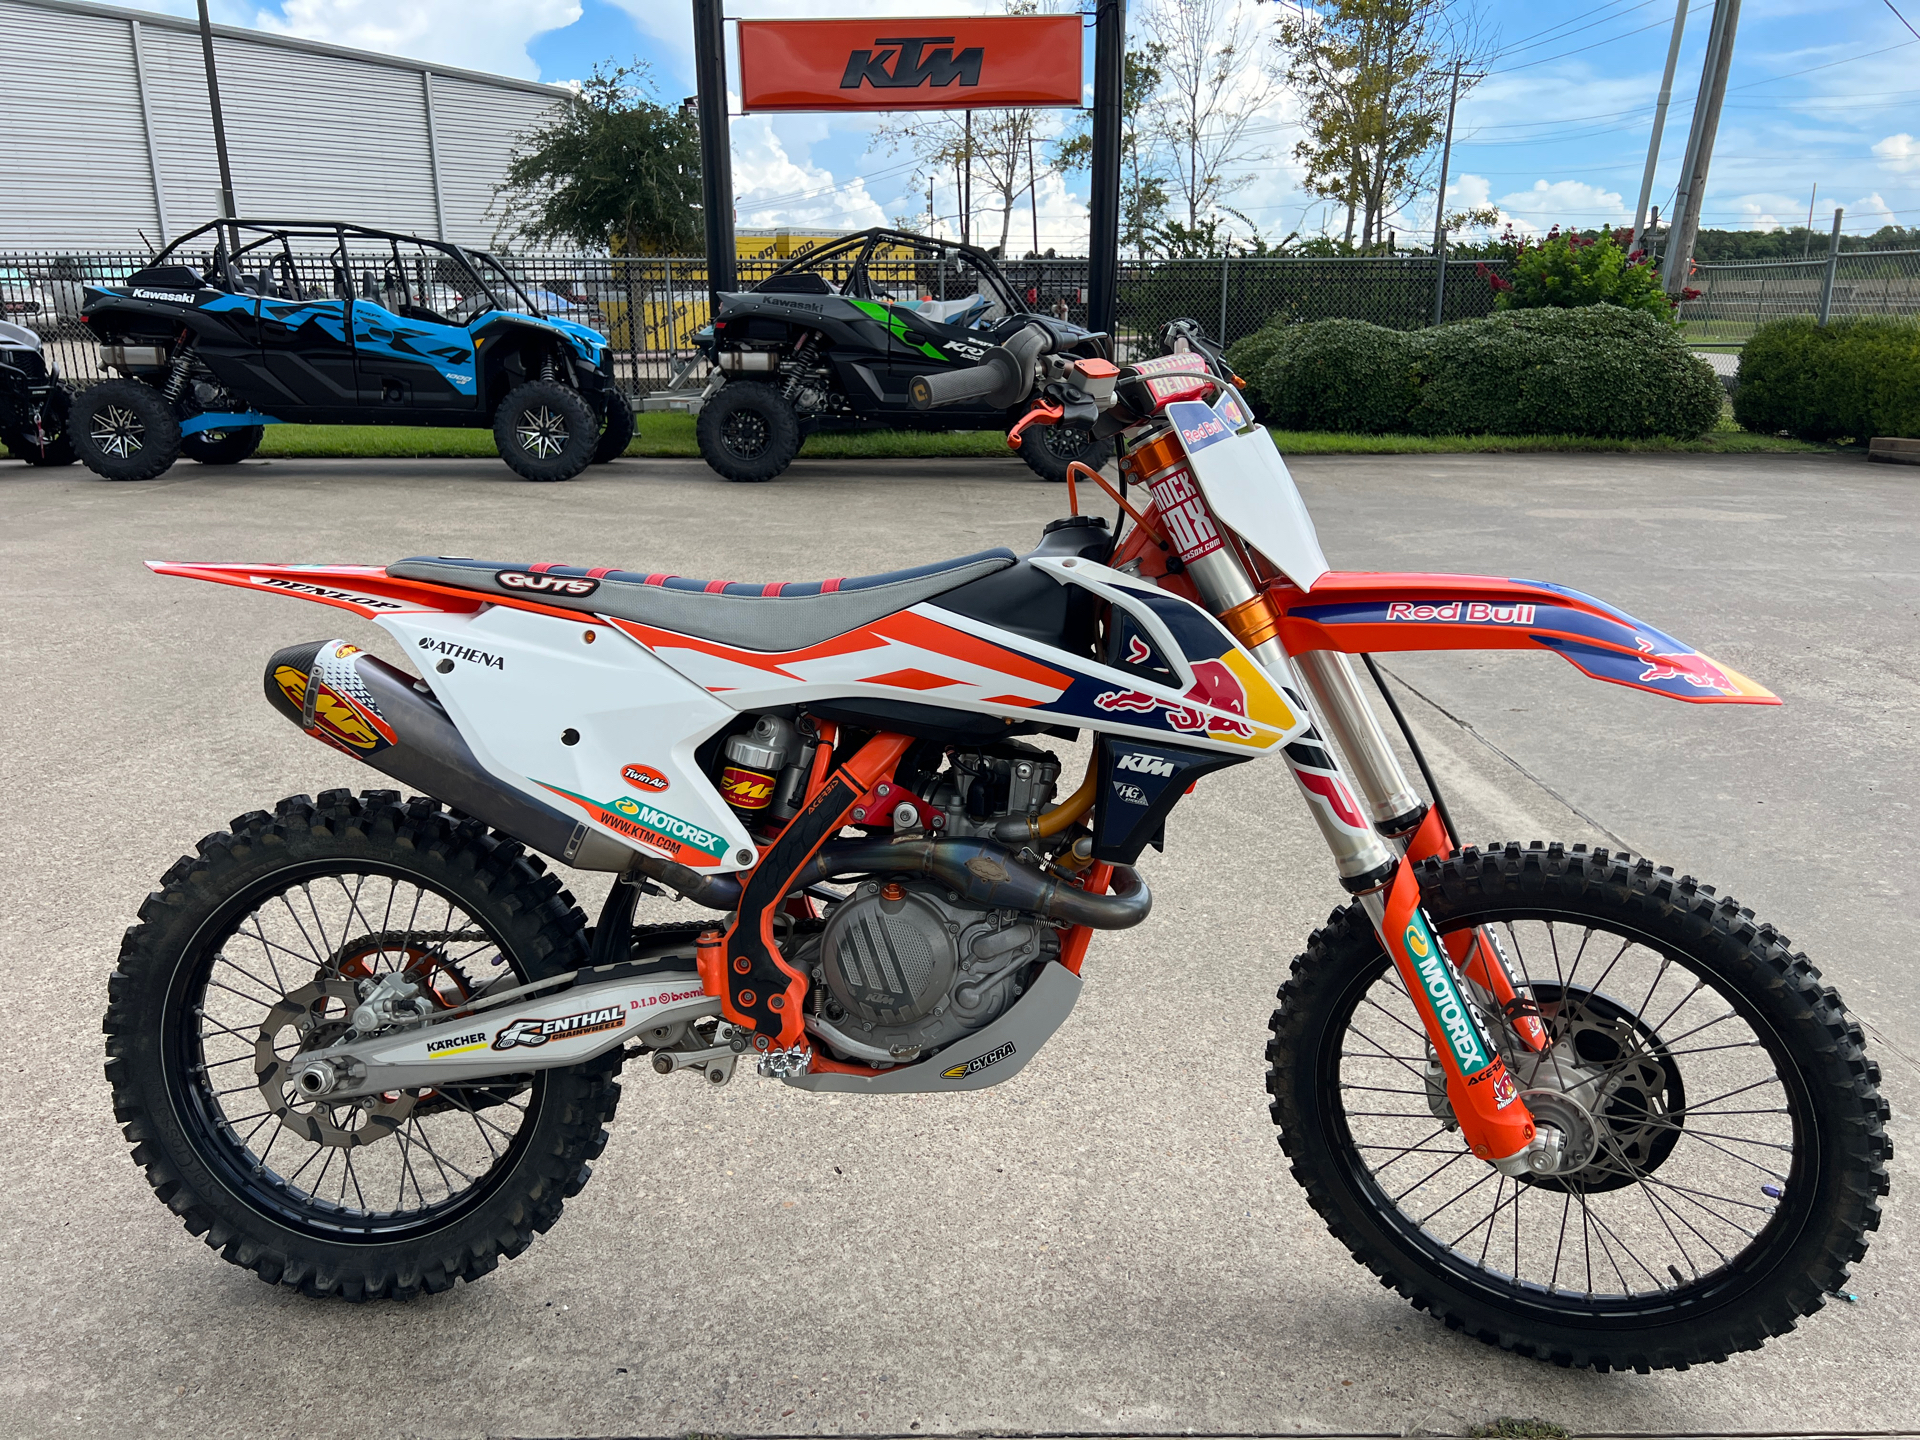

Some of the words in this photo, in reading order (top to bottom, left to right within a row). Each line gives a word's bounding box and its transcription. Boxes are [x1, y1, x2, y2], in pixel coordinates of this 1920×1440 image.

[839, 36, 985, 89] KTM
[132, 288, 196, 304] Kawasaki
[762, 295, 824, 313] Kawasaki
[445, 372, 473, 382] 1000
[1182, 424, 1206, 445] Red
[1203, 417, 1225, 436] Bull
[262, 578, 402, 610] DUNLOP
[499, 572, 595, 594] GUTS
[1386, 602, 1462, 621] Red
[1465, 602, 1536, 625] Bull
[432, 641, 504, 671] ATHENA
[1116, 752, 1175, 778] KTM
[625, 767, 649, 784] Twin
[649, 777, 668, 789] Air
[808, 779, 840, 816] ACERBIS
[600, 811, 682, 854] WWW.KTM.COM
[638, 806, 719, 852] MOTOREX
[630, 996, 658, 1010] D.I.D
[670, 986, 705, 1002] bremb
[864, 992, 895, 1005] KTM
[1419, 955, 1483, 1071] MOTOREX
[427, 1032, 487, 1052] KÄRCHER
[551, 1020, 624, 1041] CHAINWHEELS
[969, 1042, 1015, 1073] CYCRA
